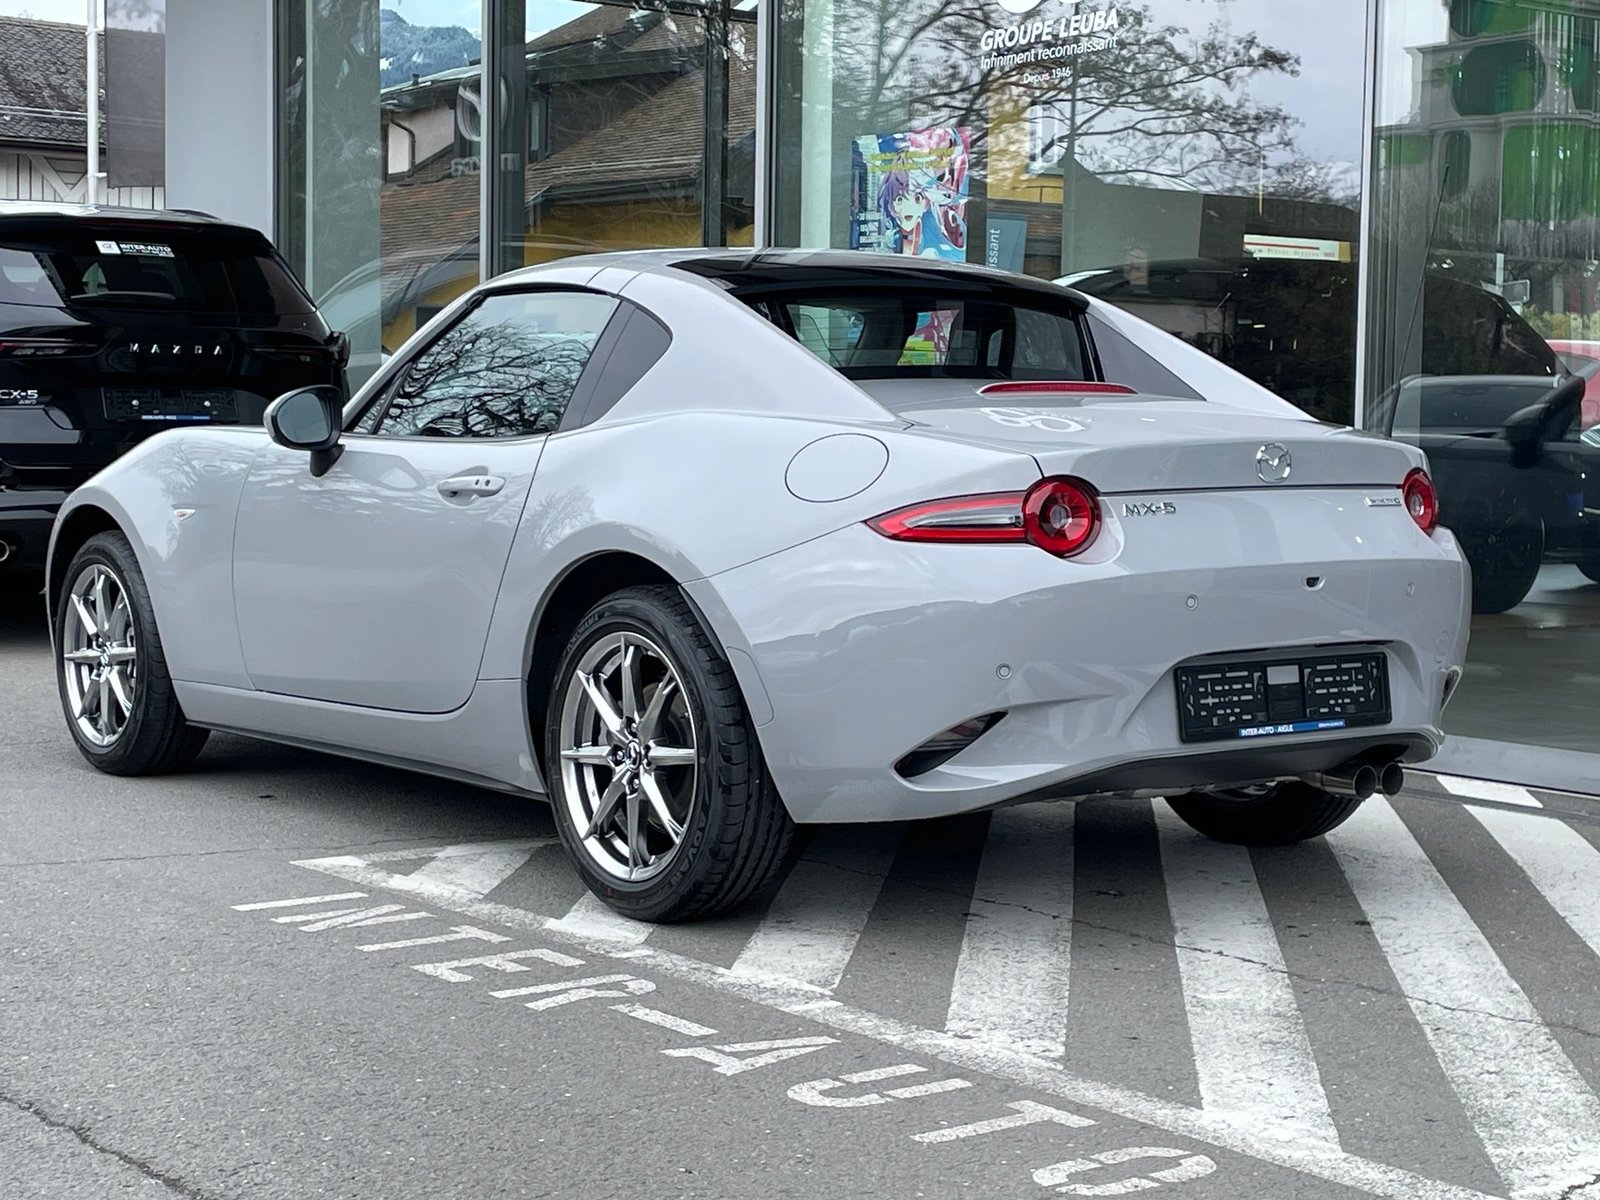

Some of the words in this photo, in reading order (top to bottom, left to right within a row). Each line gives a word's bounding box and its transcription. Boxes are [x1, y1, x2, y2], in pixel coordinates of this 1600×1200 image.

[981, 20, 1054, 51] GROUPE
[1059, 8, 1119, 38] LEUBA
[981, 52, 1035, 70] Infiniment
[1038, 36, 1118, 60] reconnaissant
[1023, 70, 1050, 84] Depuis
[1051, 66, 1072, 79] 1946
[129, 343, 223, 355] MAZDA
[0, 389, 39, 399] CX-5
[1123, 501, 1177, 517] MX-5
[231, 891, 1218, 1196] INTER-AUTO
